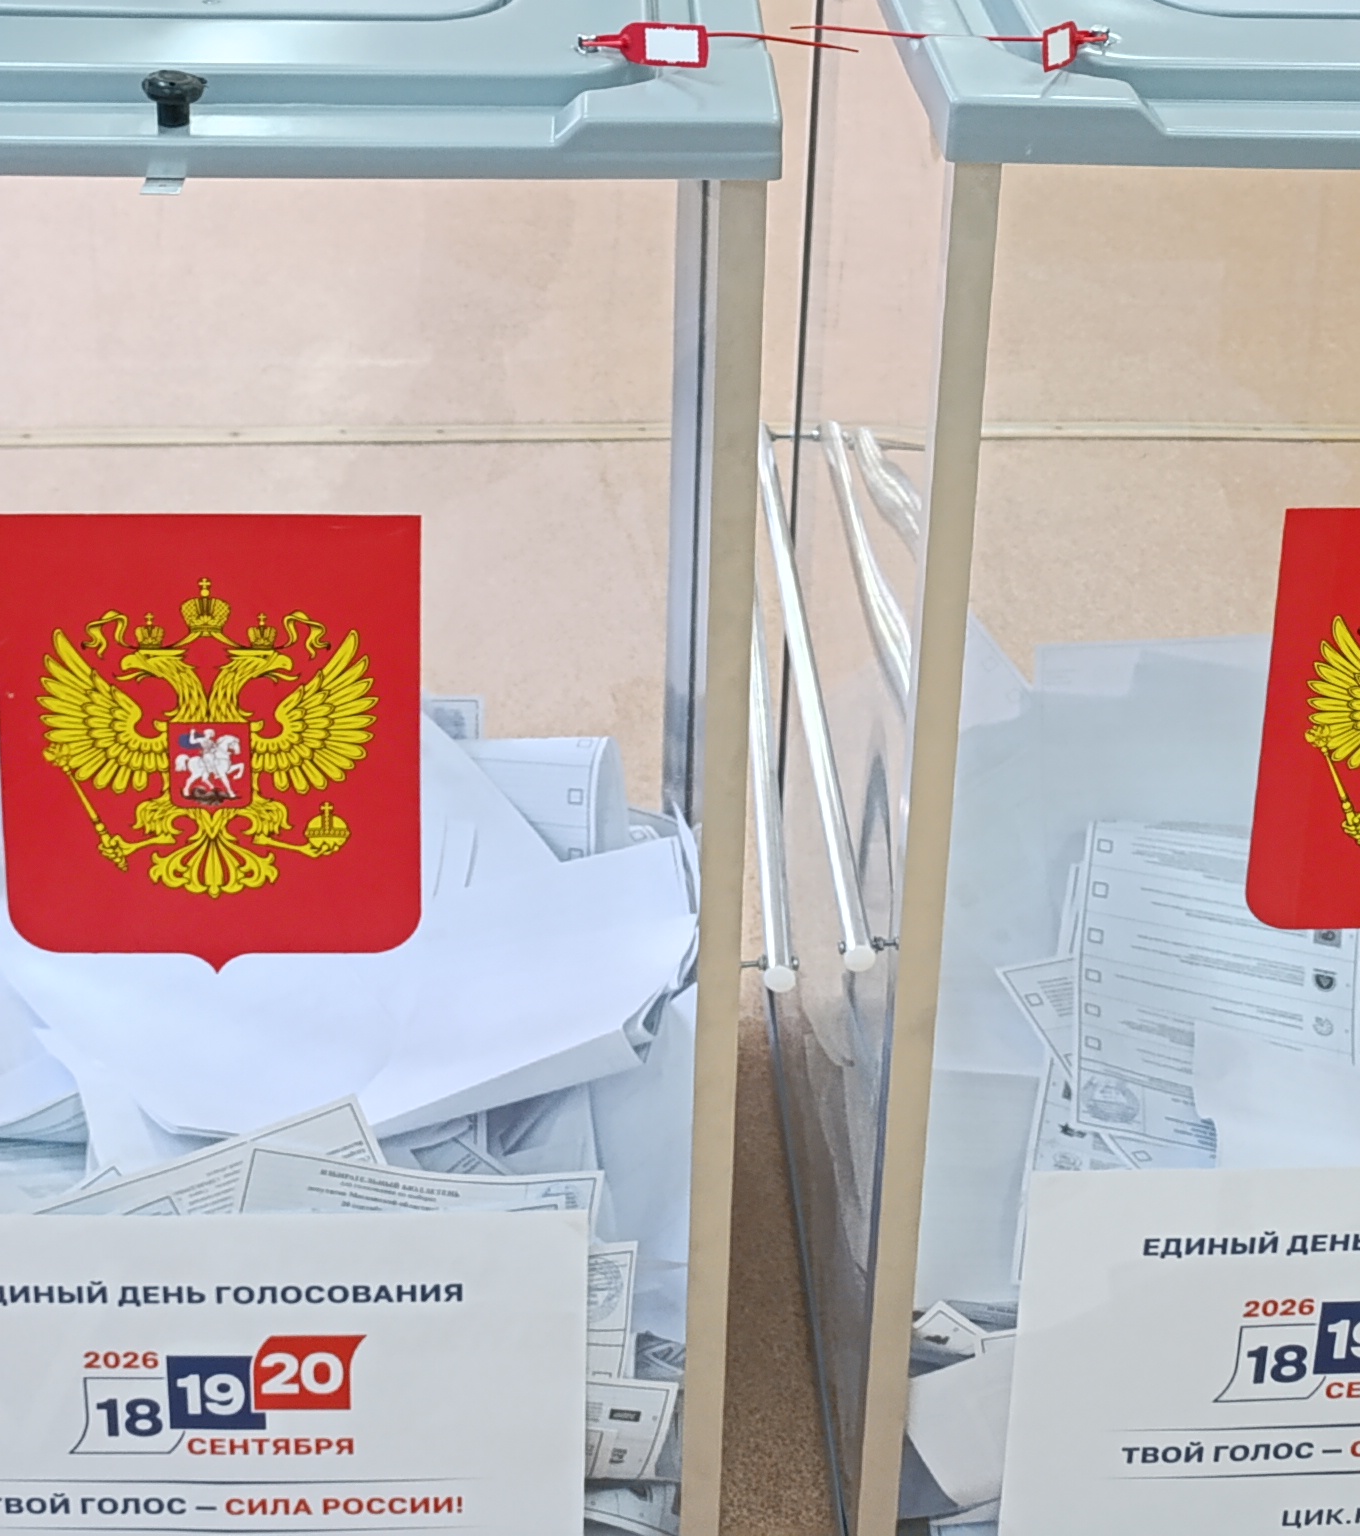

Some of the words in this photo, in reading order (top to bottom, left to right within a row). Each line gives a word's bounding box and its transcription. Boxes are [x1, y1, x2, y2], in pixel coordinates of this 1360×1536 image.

[1143, 1231, 1278, 1259] ЕДИНЫЙ
[118, 1286, 205, 1307] ДЕНЬ
[216, 1284, 462, 1304] ГОЛОСОВАНИЯ
[1243, 1299, 1314, 1317] 2026
[84, 1352, 158, 1368] 2026
[1247, 1345, 1307, 1384] 18
[97, 1399, 163, 1437] 18
[177, 1374, 244, 1415] 19
[261, 1353, 343, 1394] 20
[188, 1438, 353, 1455] СЕНТЯБРЯ
[1122, 1442, 1203, 1464] ТВОЙ
[1214, 1442, 1314, 1462] ГОЛОС
[81, 1498, 186, 1514] ГОЛОС
[226, 1499, 312, 1515] СИЛА
[323, 1497, 462, 1514] РОССИИ!
